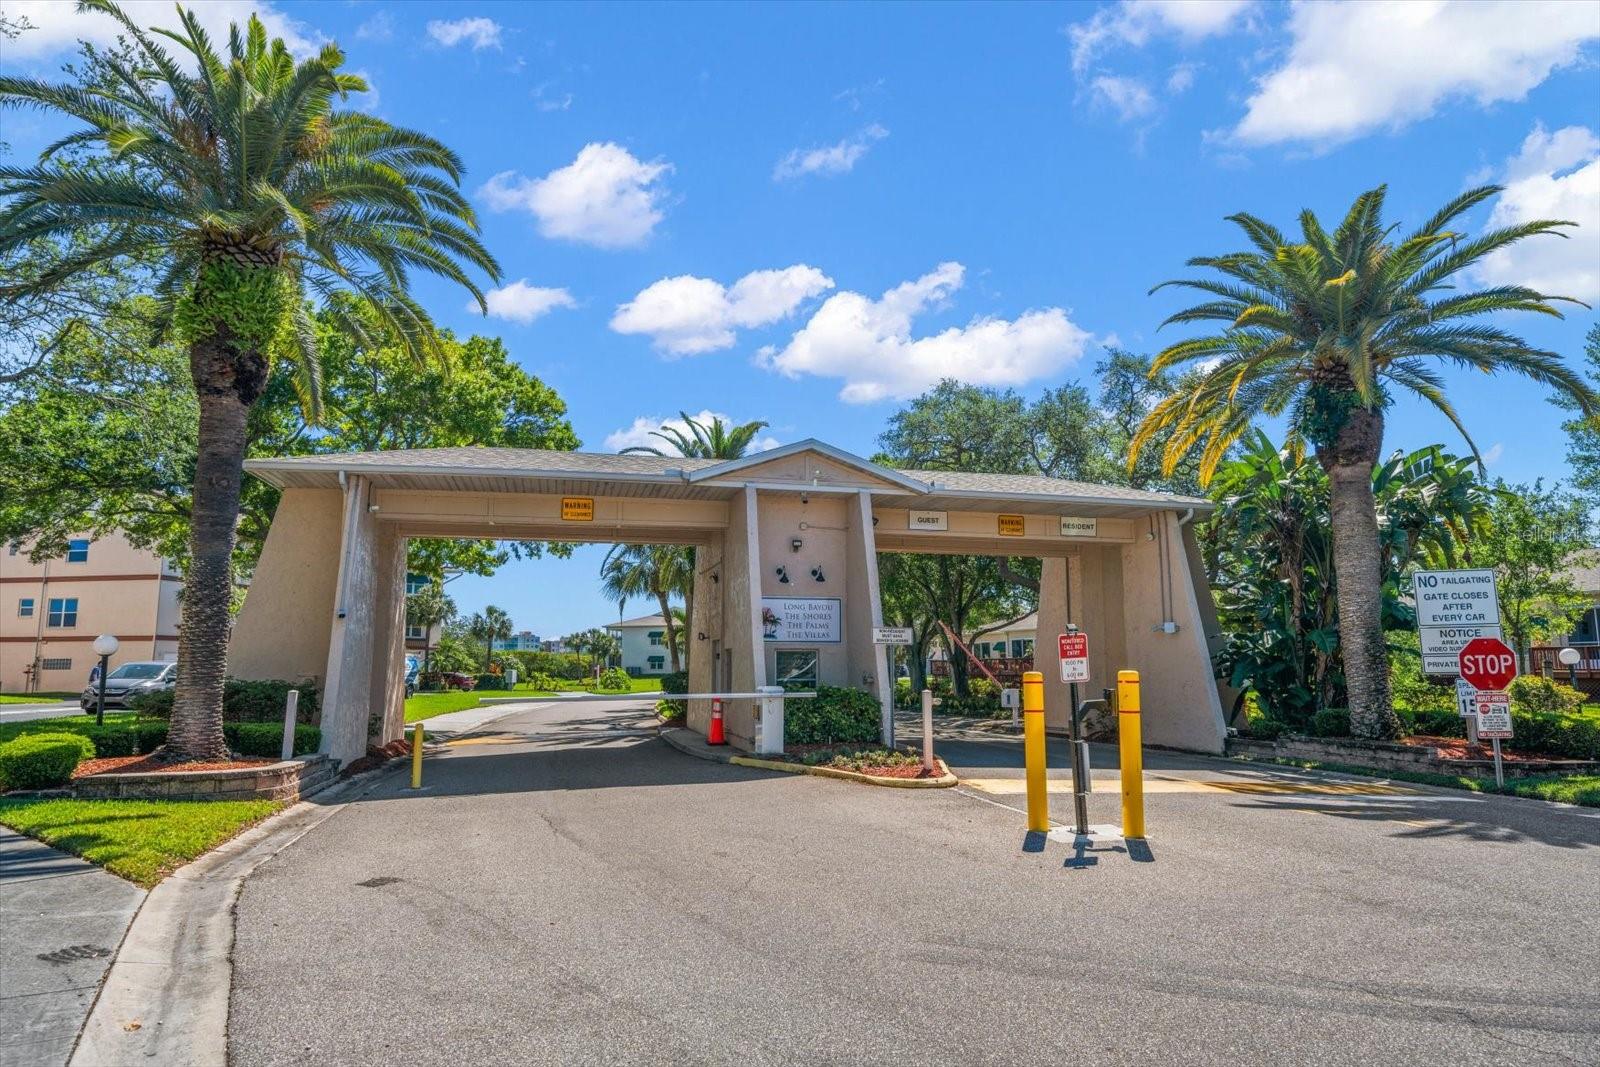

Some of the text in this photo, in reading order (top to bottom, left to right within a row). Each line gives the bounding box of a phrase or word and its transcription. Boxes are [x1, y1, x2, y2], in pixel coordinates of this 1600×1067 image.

[1418, 576, 1490, 588] NO TAILGATING
[1442, 602, 1472, 610] AFTER
[1440, 628, 1481, 638] NOTICE
[1463, 654, 1512, 675] STOP
[1462, 699, 1476, 712] 15
